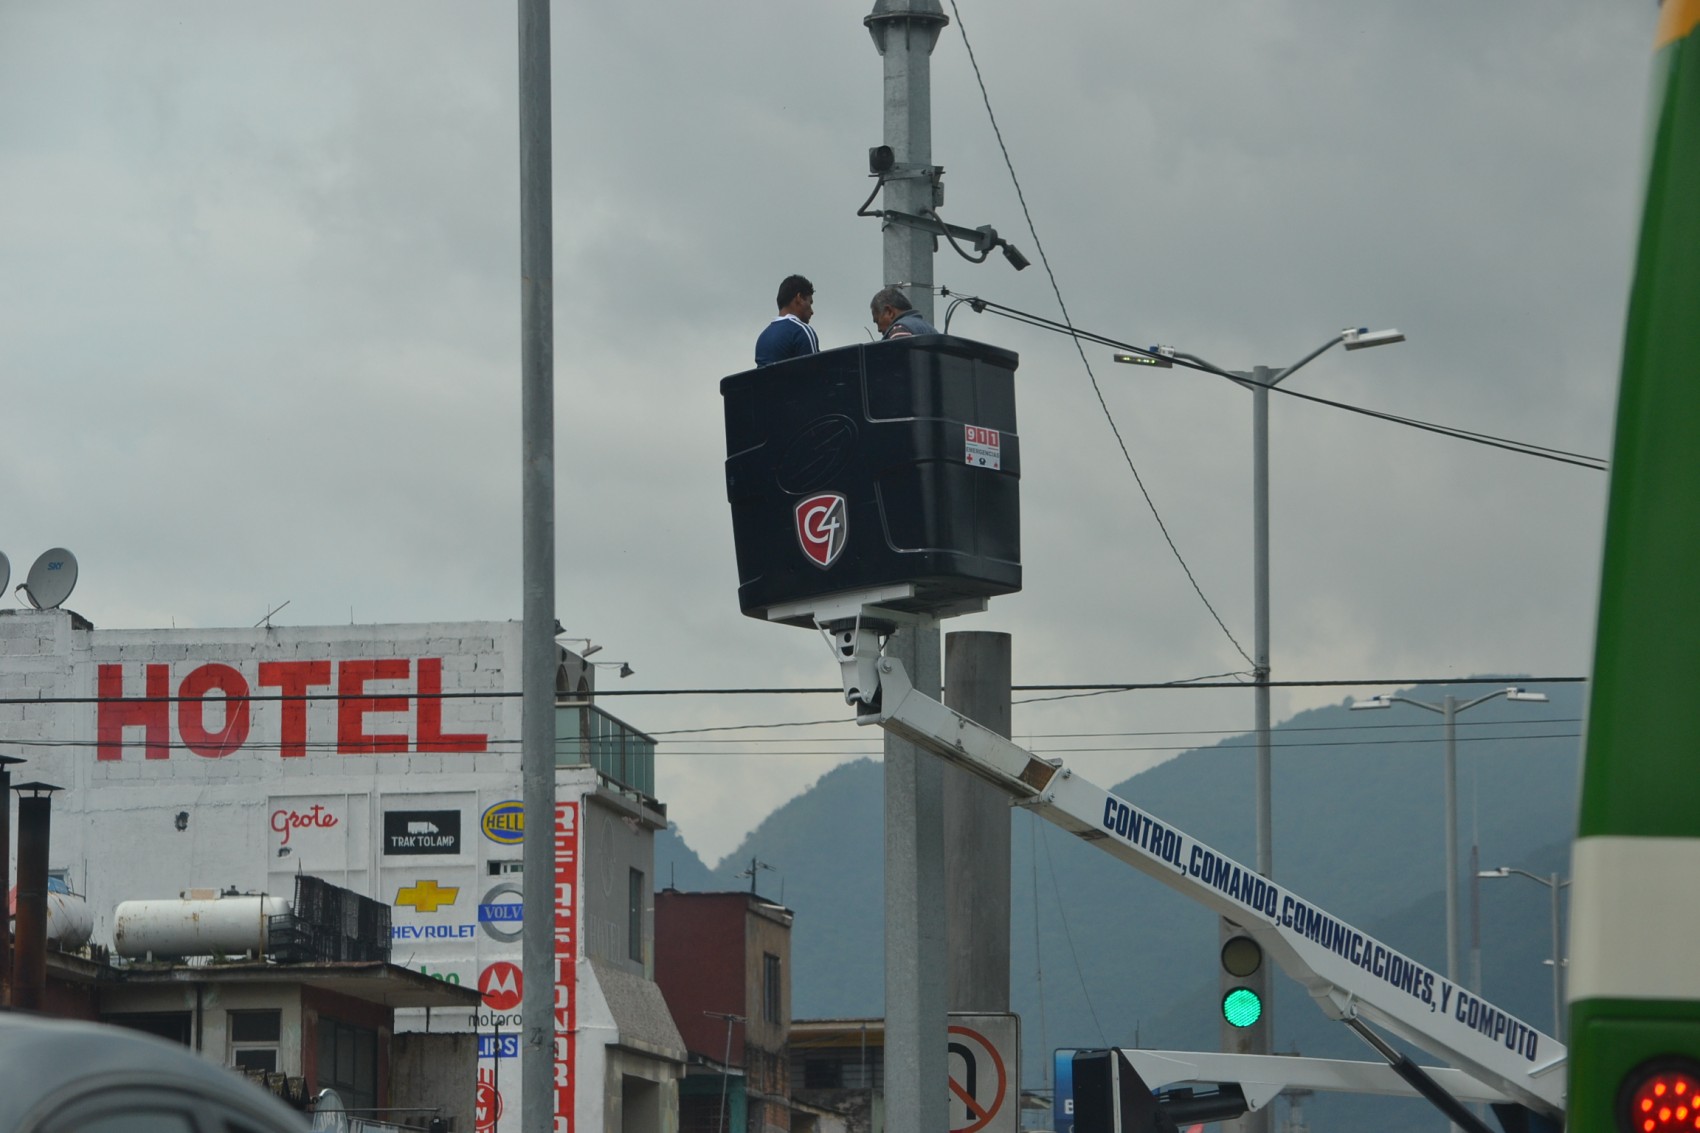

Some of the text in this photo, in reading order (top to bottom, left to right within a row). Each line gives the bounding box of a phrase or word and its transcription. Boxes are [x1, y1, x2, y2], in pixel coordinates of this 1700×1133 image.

[967, 428, 997, 446] 911
[47, 562, 63, 570] SKY
[97, 657, 488, 761] HOTEL
[271, 804, 339, 845] Grote
[1103, 797, 1539, 1062] CONTROL, COMANDO, COMUNICACIONES, Y COMPUTO
